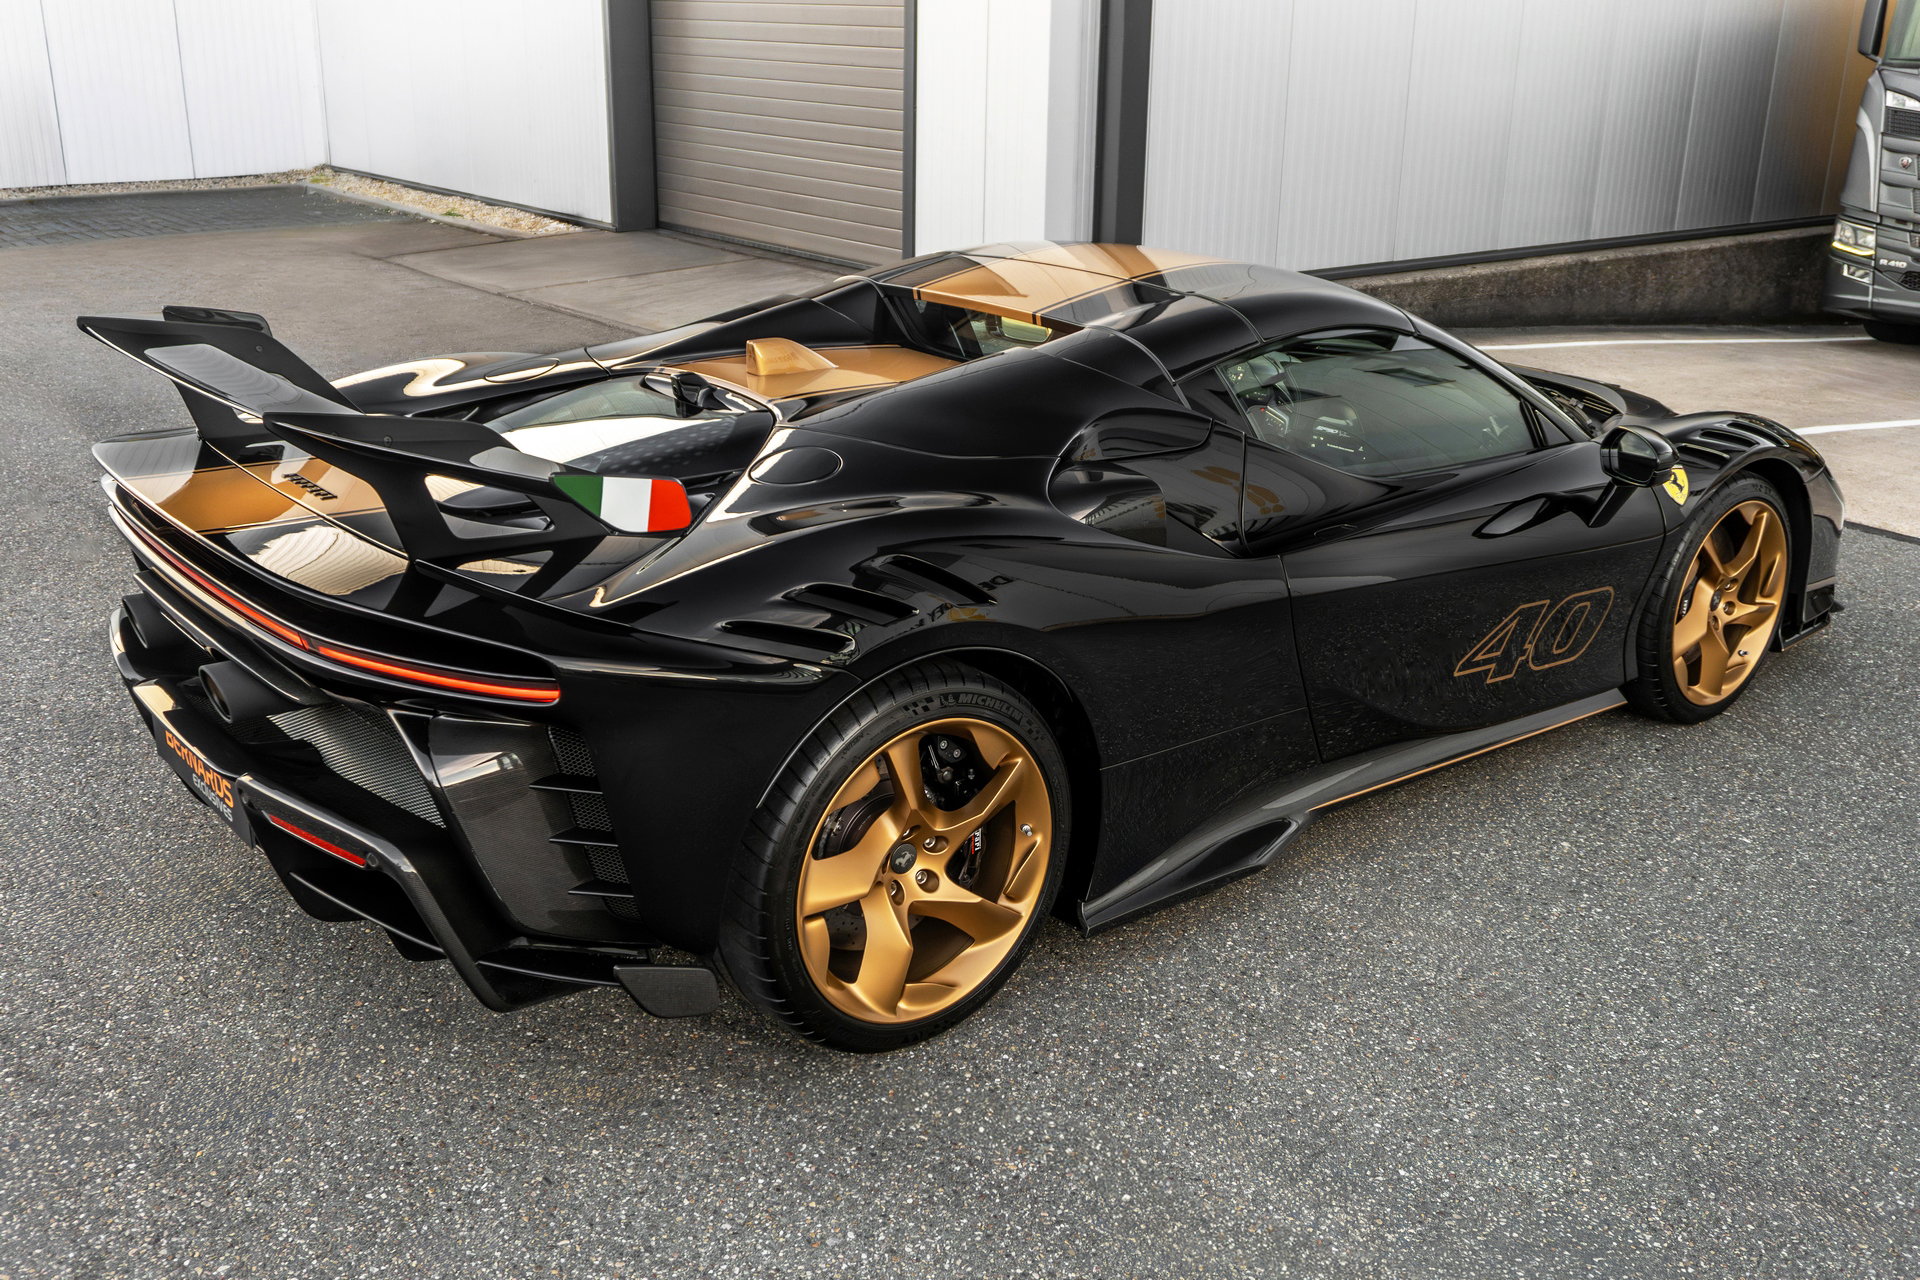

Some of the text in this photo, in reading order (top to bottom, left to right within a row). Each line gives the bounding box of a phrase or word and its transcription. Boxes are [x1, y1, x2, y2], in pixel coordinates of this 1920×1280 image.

[1888, 260, 1907, 269] 410
[1453, 585, 1615, 684] 40
[957, 692, 1024, 722] MICHELIN
